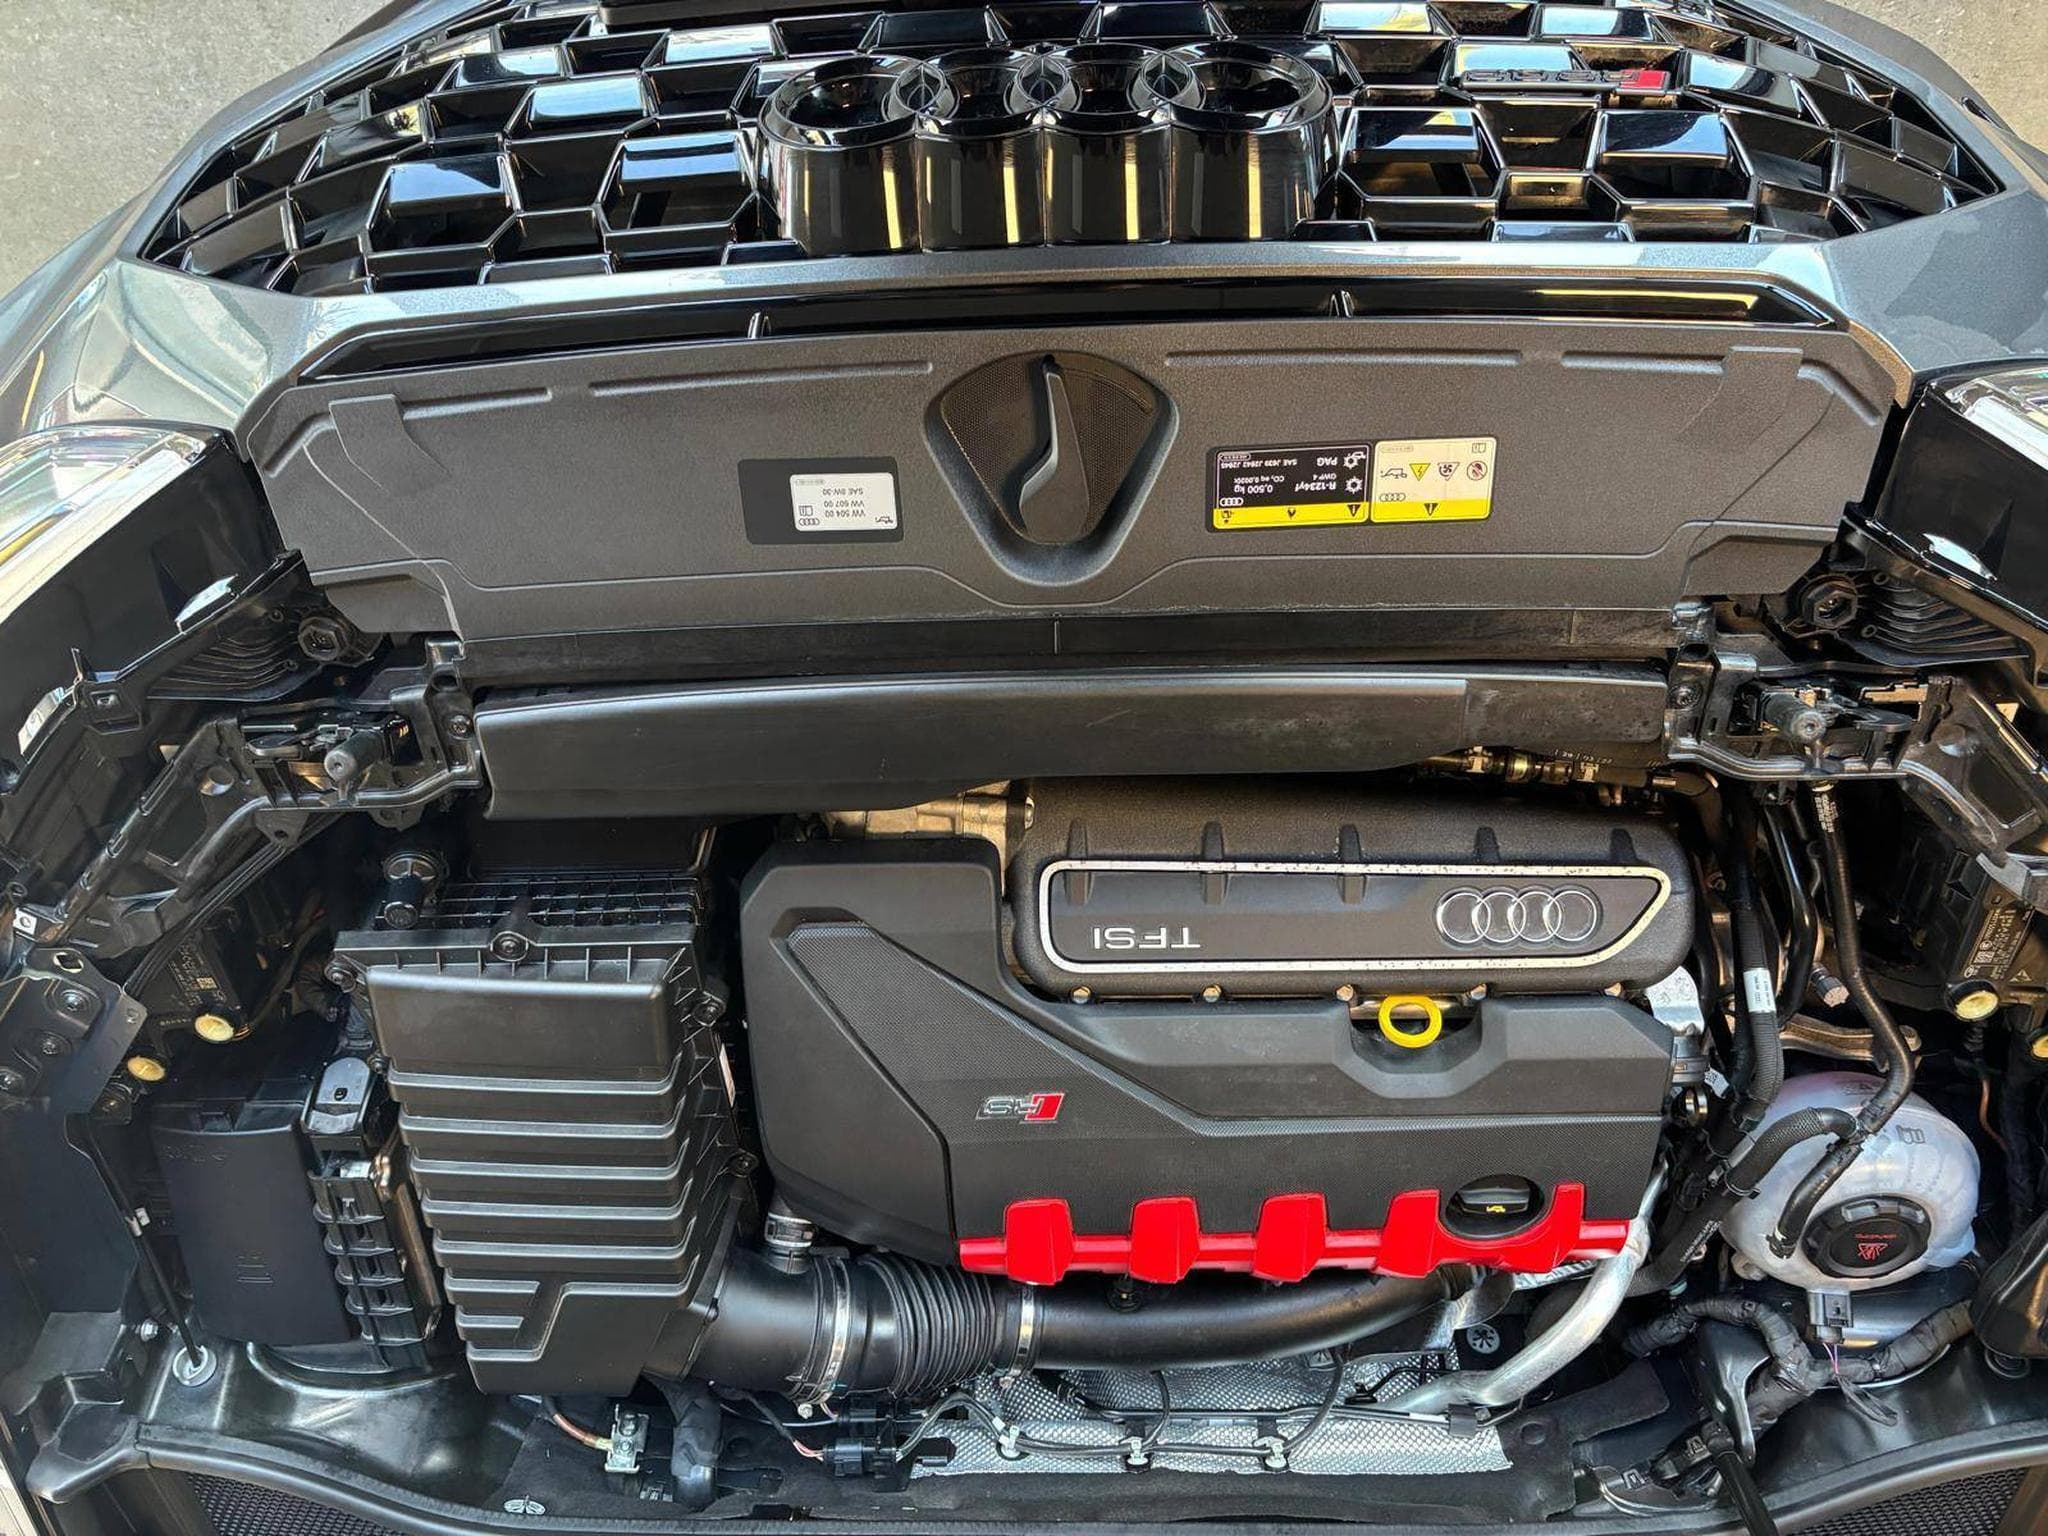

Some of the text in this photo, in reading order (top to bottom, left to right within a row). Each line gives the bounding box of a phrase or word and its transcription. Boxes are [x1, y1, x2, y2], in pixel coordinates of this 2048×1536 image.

[1317, 457, 1337, 467] PAG
[1234, 484, 1273, 494] 0,500 kg
[1294, 481, 1336, 492] R-1234yf
[851, 500, 864, 508] VW
[1093, 926, 1201, 949] TFSI
